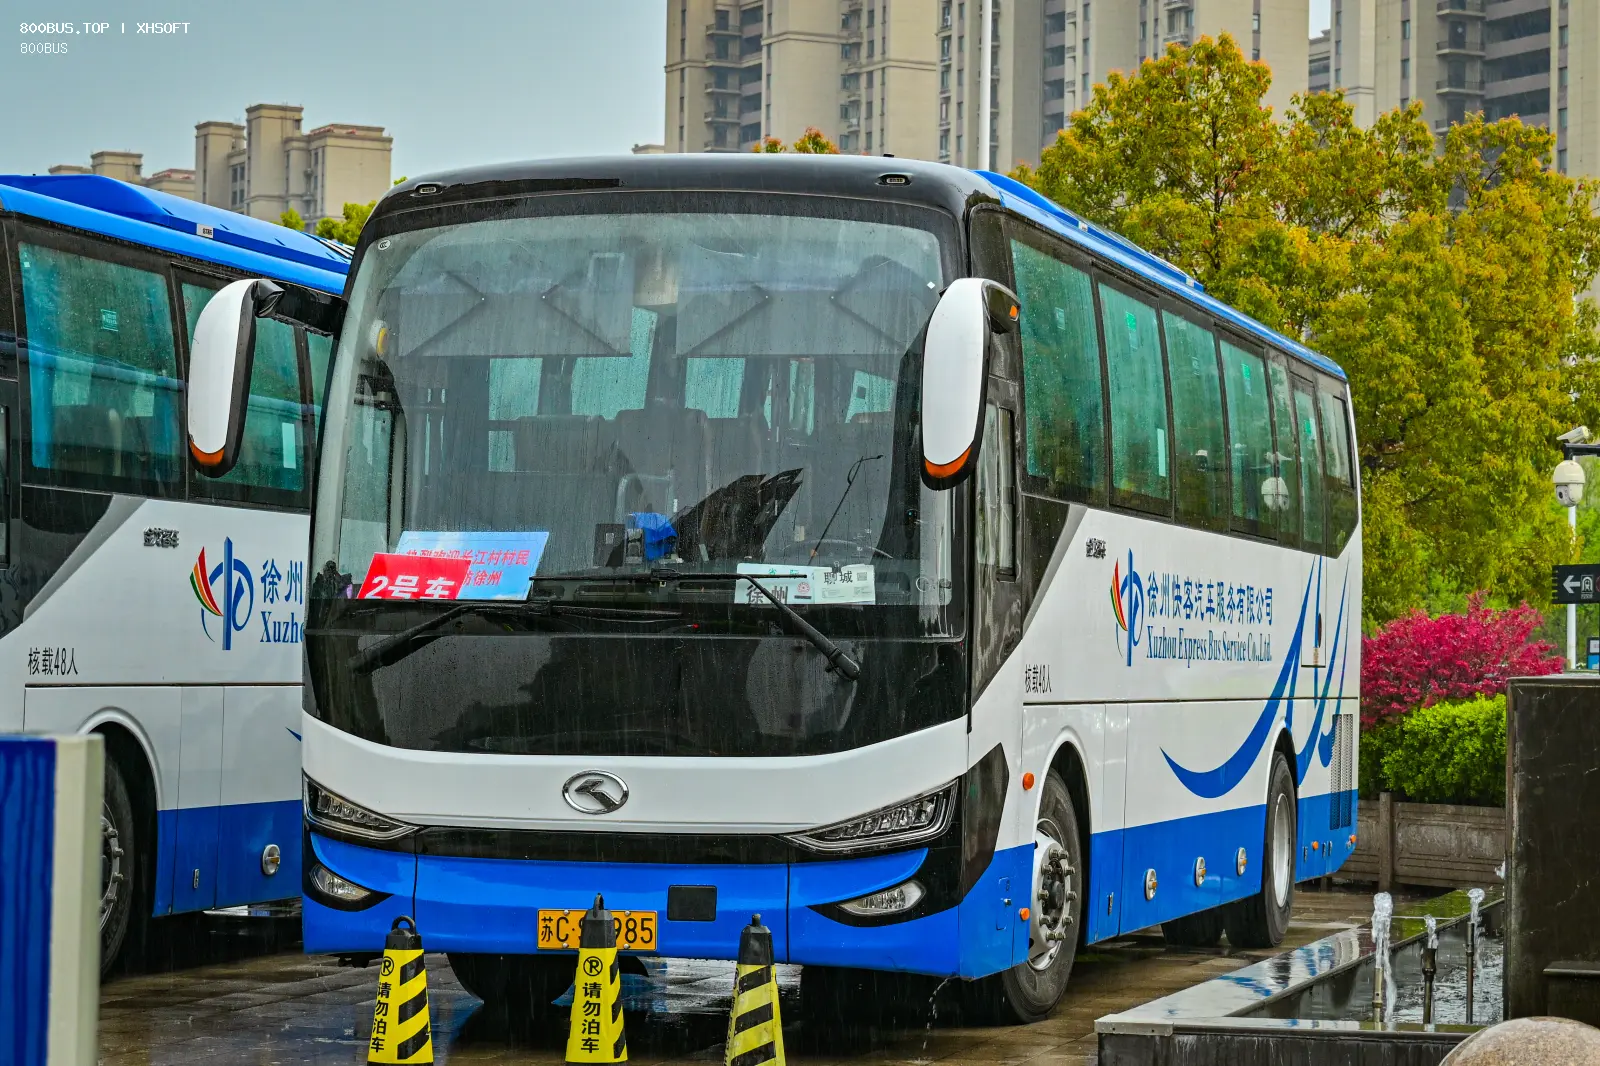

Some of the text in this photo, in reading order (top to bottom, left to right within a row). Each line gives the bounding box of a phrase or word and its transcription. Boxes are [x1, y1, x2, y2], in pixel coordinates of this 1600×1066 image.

[260, 557, 303, 606] 徐州
[364, 574, 455, 600] 2号车
[823, 570, 853, 585] 聊城
[1147, 570, 1273, 626] 徐州快客汽车服务有限公司
[27, 647, 79, 676] 核载48人
[1146, 625, 1177, 659] Xuzhou
[1178, 627, 1207, 669] Express
[1208, 629, 1221, 661] Bus
[1222, 630, 1246, 662] Service
[1025, 663, 1052, 694] 核载48人
[541, 915, 654, 944] 苏C·985
[371, 981, 392, 1053] 请勿泊车
[580, 981, 603, 1054] 请勿泊车
